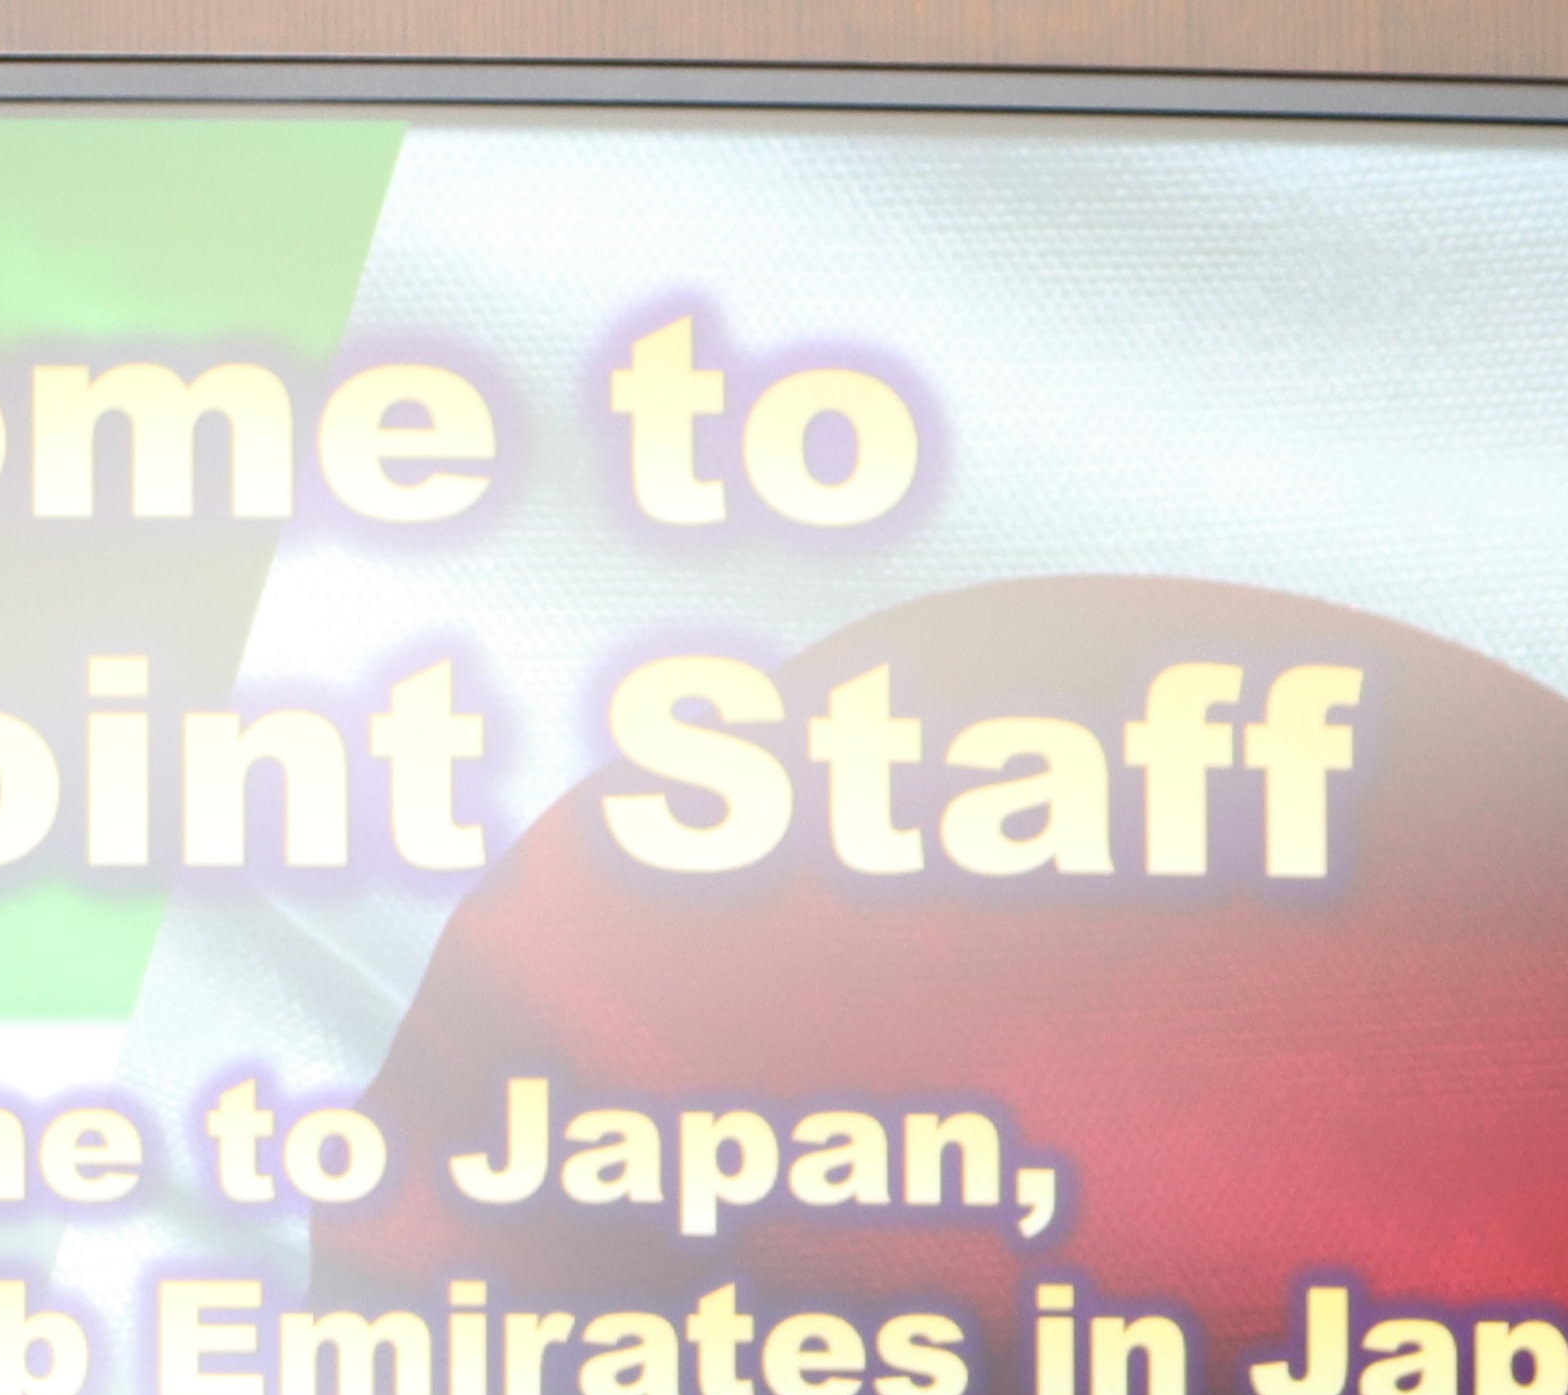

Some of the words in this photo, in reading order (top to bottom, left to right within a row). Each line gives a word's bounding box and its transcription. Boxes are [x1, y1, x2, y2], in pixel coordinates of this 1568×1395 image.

[611, 315, 918, 526] to
[602, 654, 1363, 877] Staff
[208, 1078, 387, 1205] to
[449, 1078, 1056, 1238] Japan,
